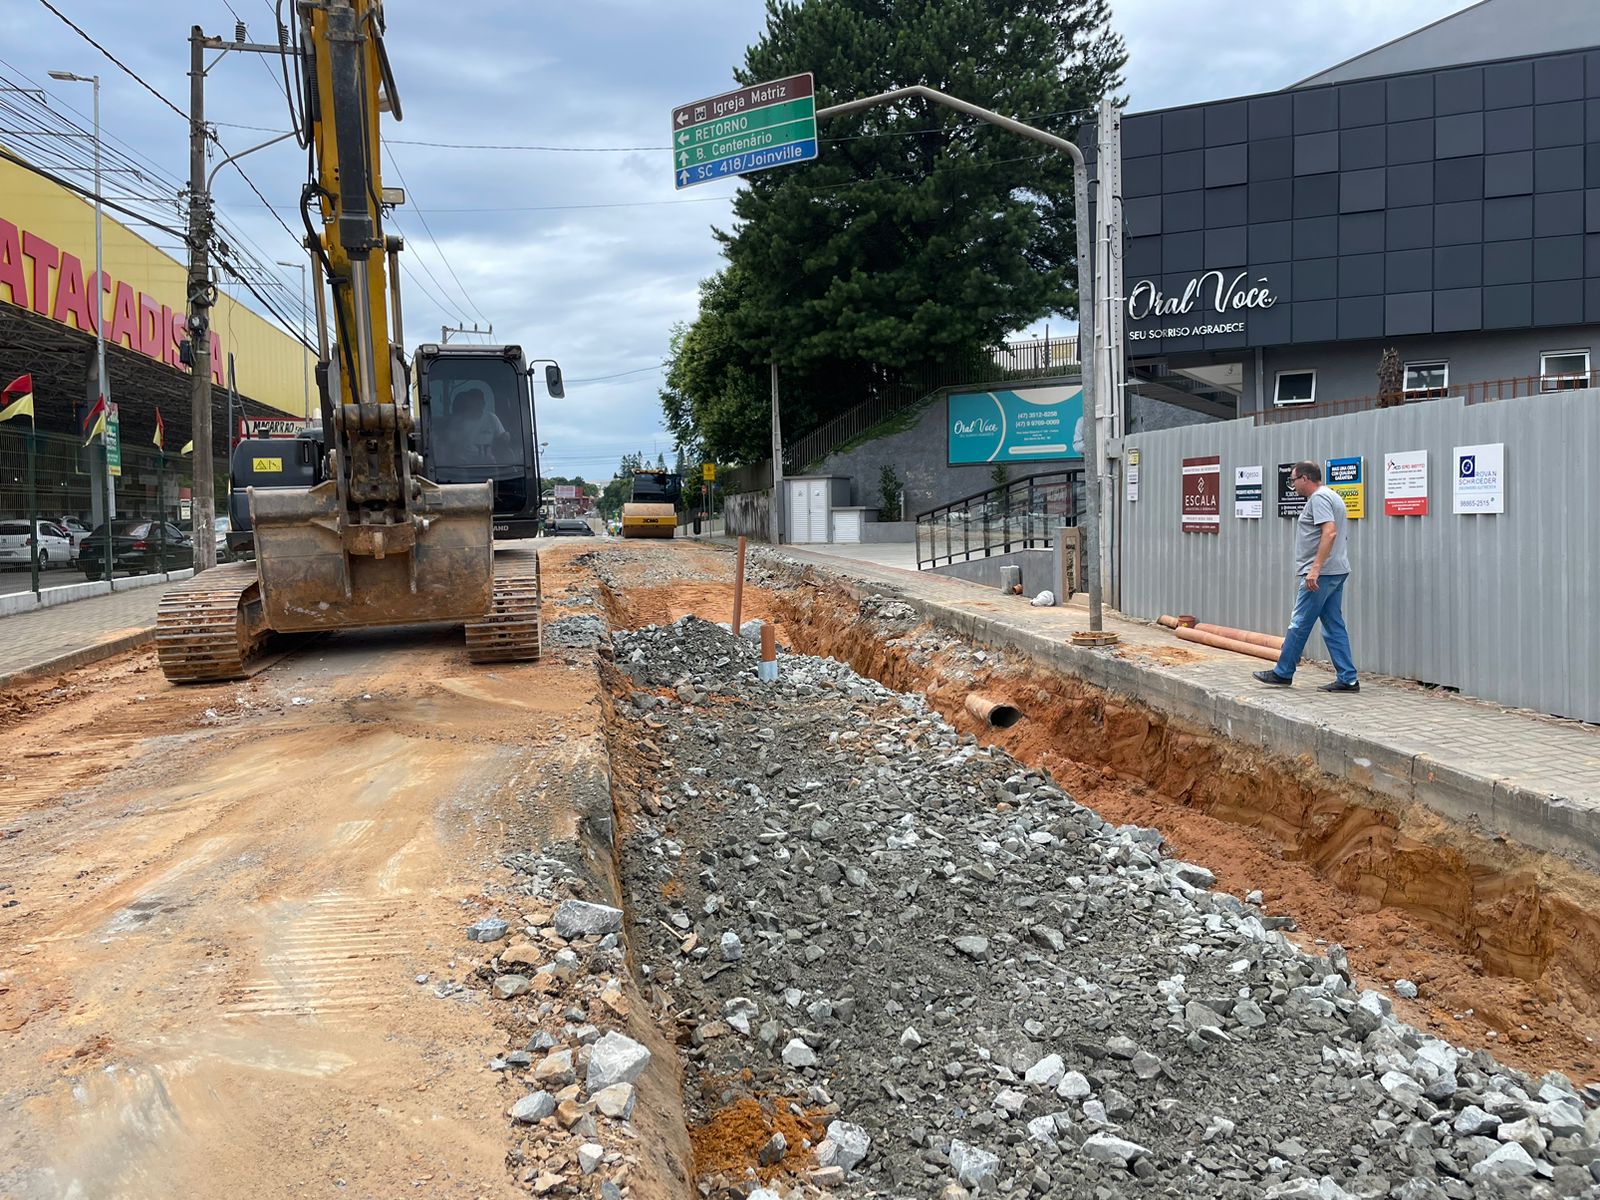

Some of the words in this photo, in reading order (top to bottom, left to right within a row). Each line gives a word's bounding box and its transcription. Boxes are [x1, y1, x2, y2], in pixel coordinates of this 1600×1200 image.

[713, 96, 745, 116] Igreja
[751, 86, 786, 104] Matriz
[695, 117, 748, 142] RETORNO
[696, 148, 706, 160] B.
[712, 132, 772, 155] Centenário
[697, 165, 713, 179] SC
[720, 145, 802, 173] 418/Joinville
[0, 217, 224, 385] ATACADISA
[1129, 278, 1197, 320] Oral
[1196, 271, 1277, 313] Você
[1129, 330, 1147, 341] SEU
[1149, 326, 1190, 339] SORRISO
[1192, 322, 1245, 336] AGRADECE
[954, 420, 975, 435] Oral
[1458, 477, 1497, 486] SCHROEDER
[1185, 494, 1217, 507] ESCALA
